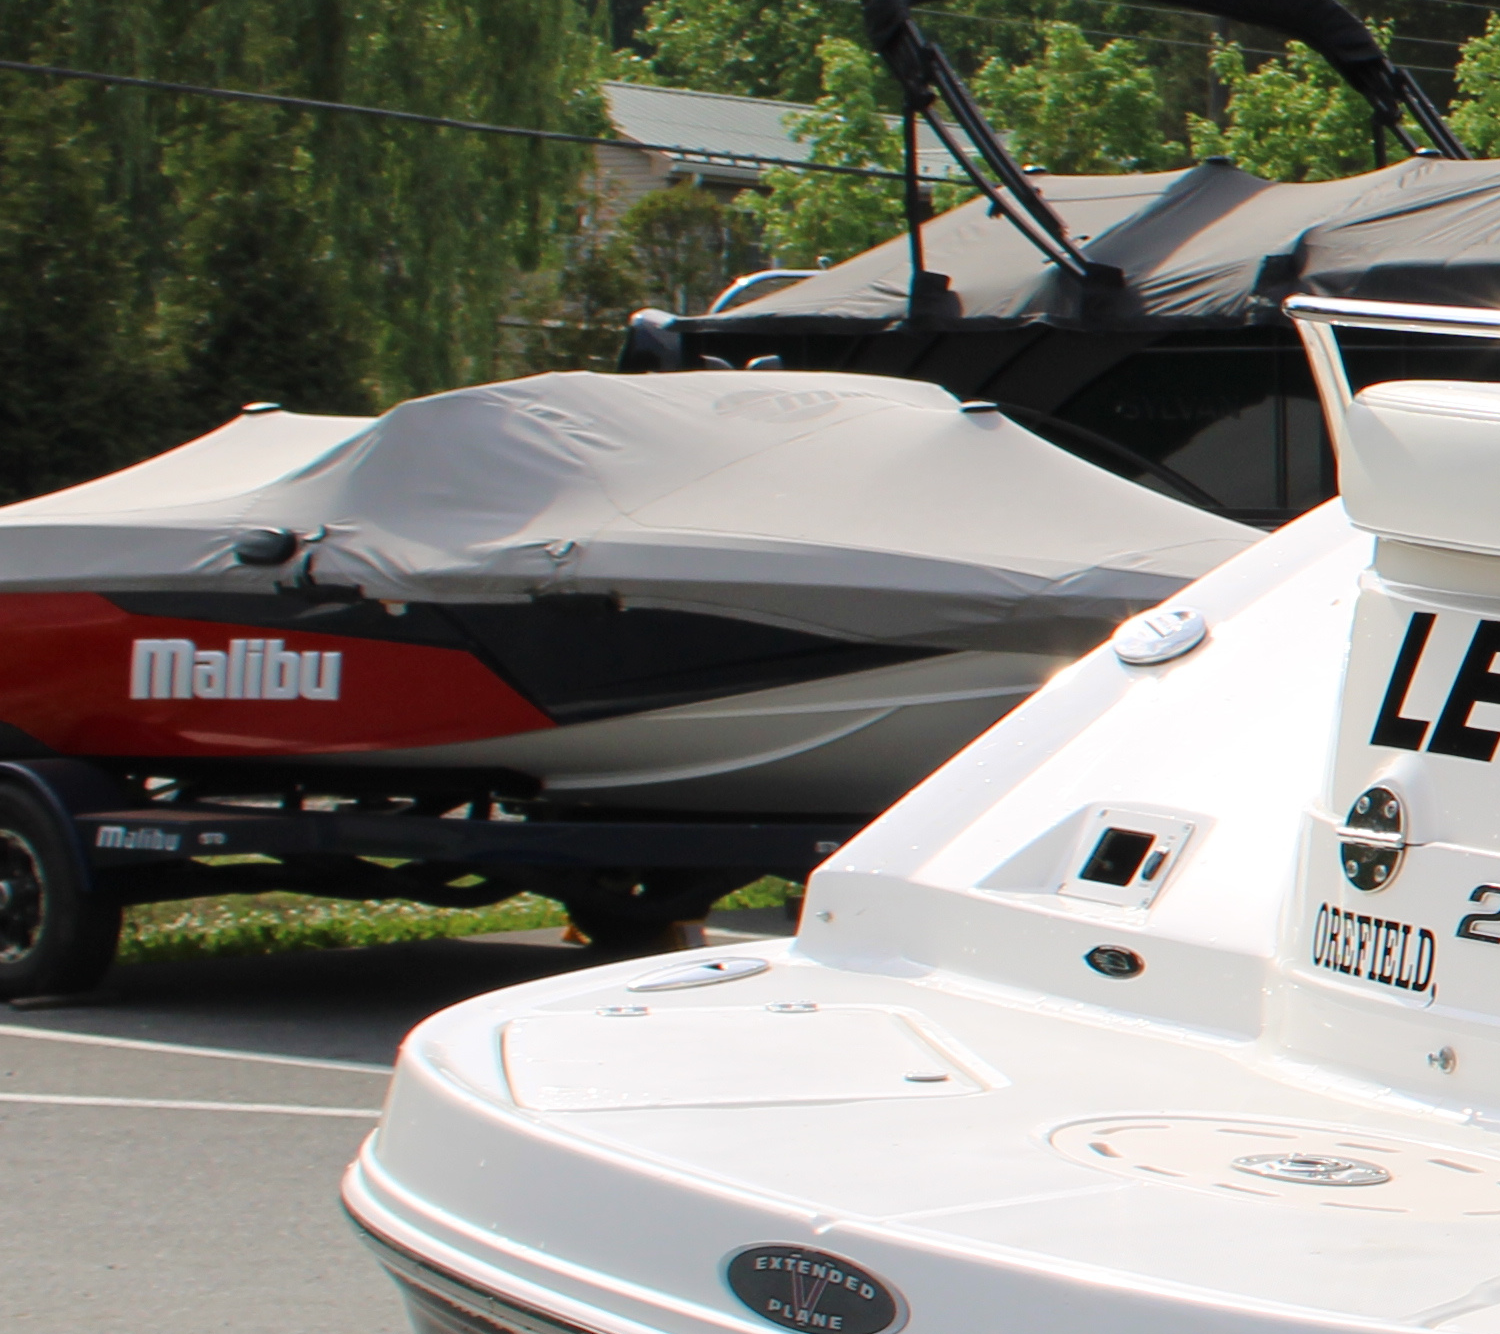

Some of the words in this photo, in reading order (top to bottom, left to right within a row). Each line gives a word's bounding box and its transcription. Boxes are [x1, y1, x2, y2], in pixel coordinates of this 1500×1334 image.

[130, 638, 342, 701] Malibu
[1312, 902, 1437, 1004] OREFIELD,
[755, 1255, 877, 1301] EXTENDED
[767, 1298, 843, 1331] PLANE
